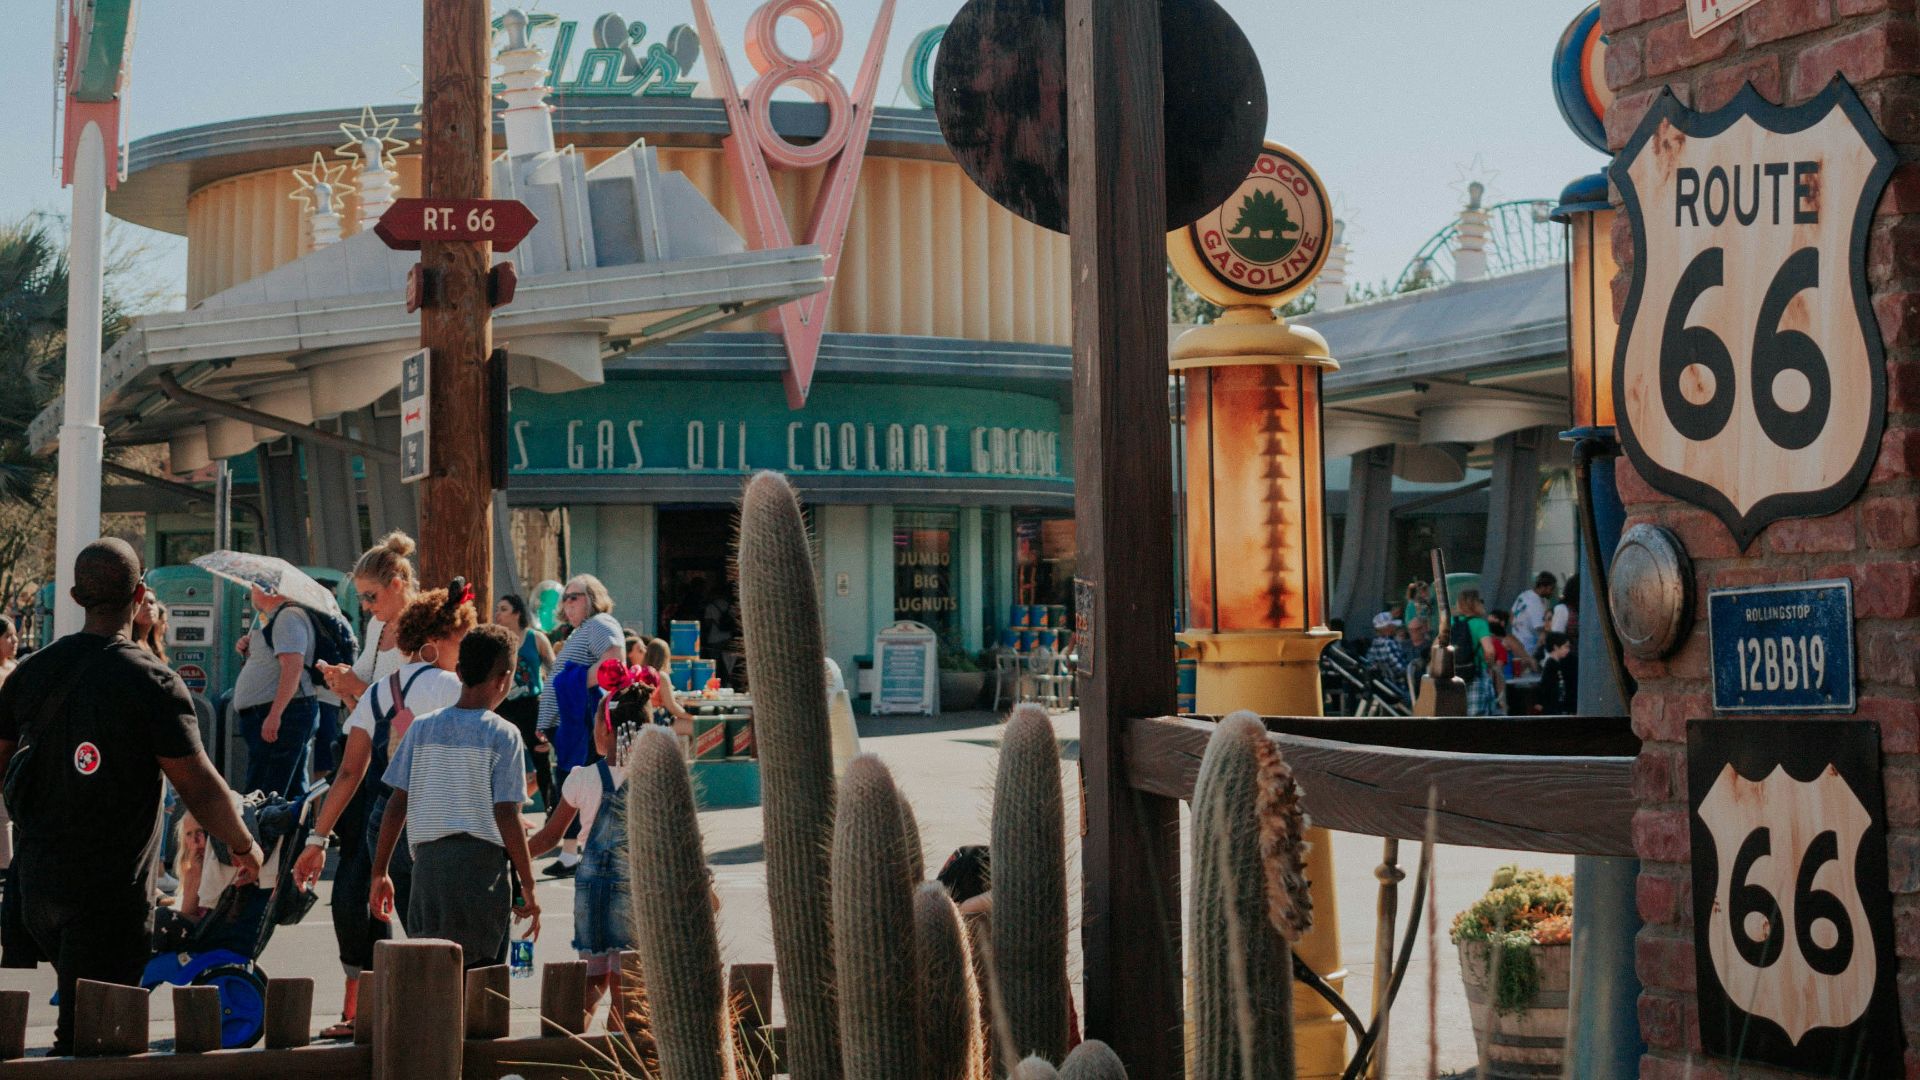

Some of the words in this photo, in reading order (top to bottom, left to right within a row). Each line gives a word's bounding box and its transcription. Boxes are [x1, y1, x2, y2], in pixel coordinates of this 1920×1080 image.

[1250, 157, 1309, 197] OCO
[1675, 160, 1820, 227] ROUTE
[423, 207, 457, 231] RT.
[466, 208, 496, 232] 66
[1204, 230, 1318, 285] GASOLINE
[1659, 246, 1832, 451] 66
[567, 420, 644, 470] GAS
[687, 420, 750, 470] OIL
[787, 421, 948, 473] COOLANT
[898, 552, 950, 566] JUMBO
[913, 574, 939, 589] BIG
[1745, 604, 1811, 622] ROLLINGSTOP
[1737, 634, 1825, 691] 12BB19
[1729, 826, 1854, 976] 66
